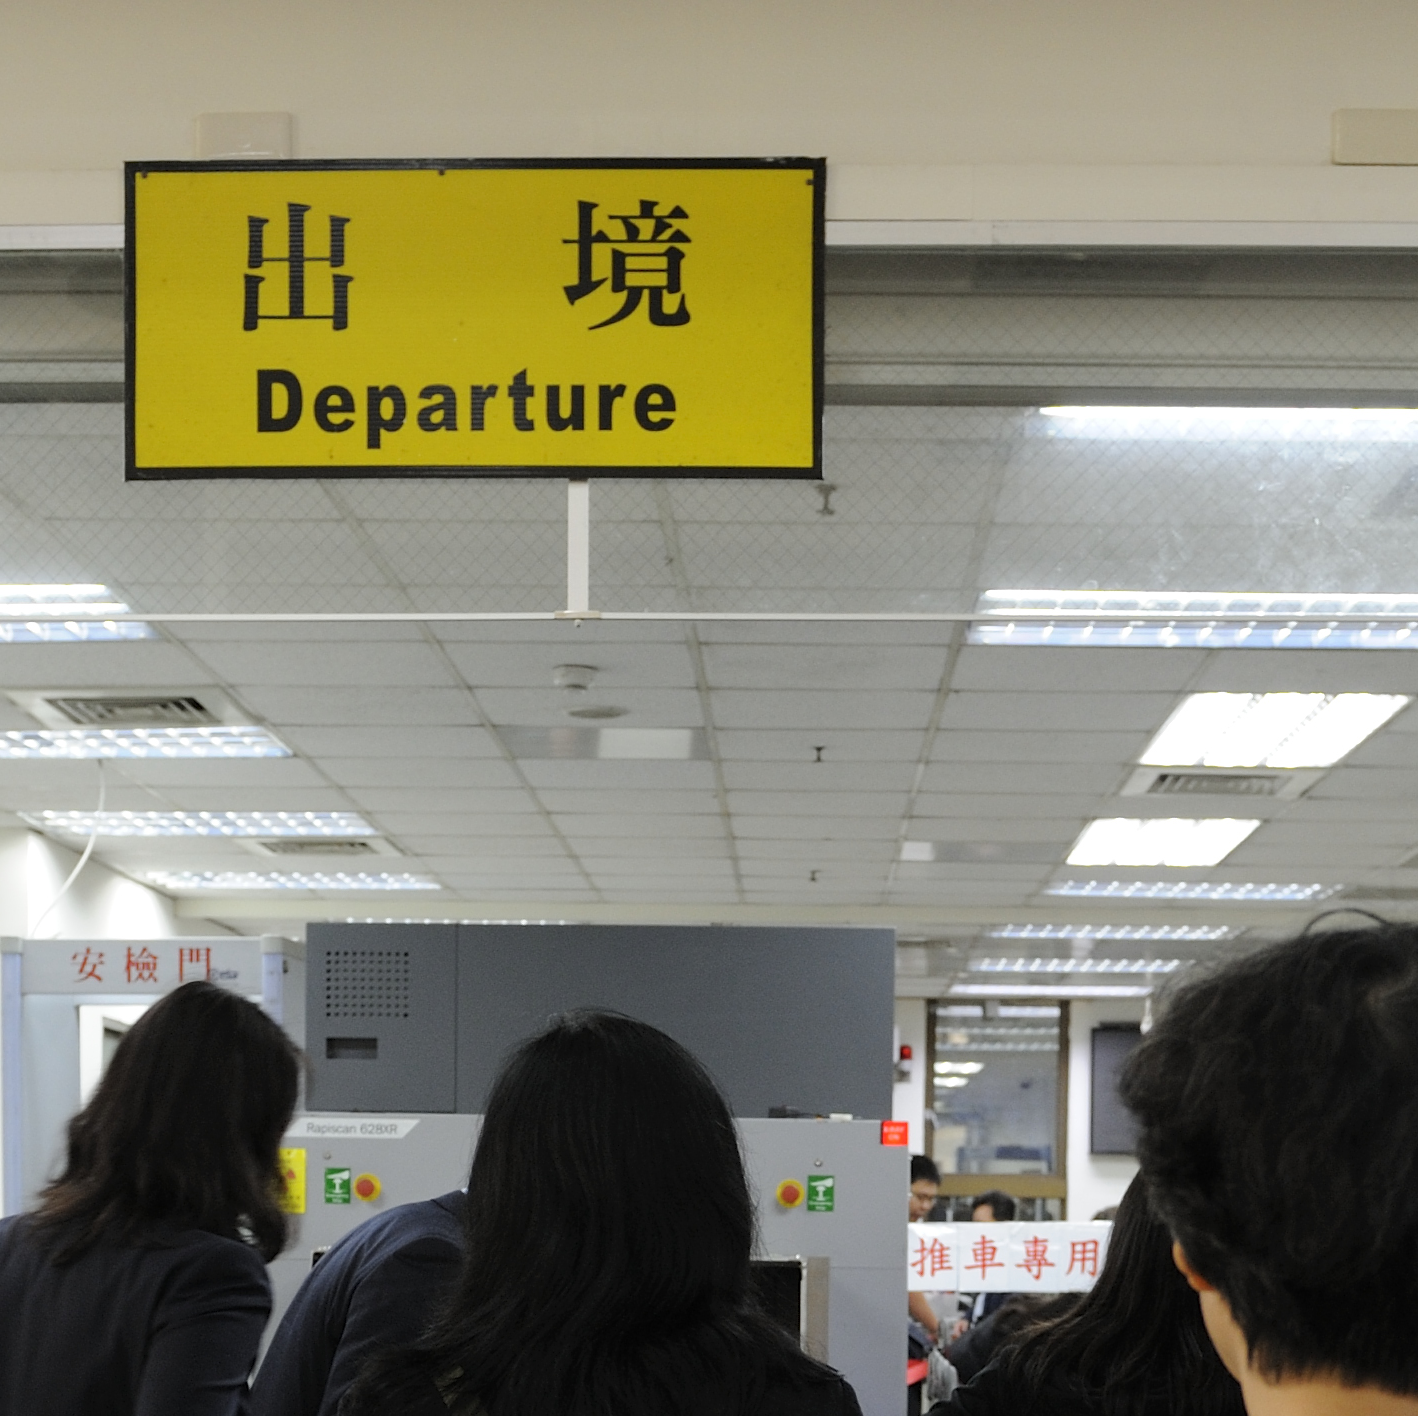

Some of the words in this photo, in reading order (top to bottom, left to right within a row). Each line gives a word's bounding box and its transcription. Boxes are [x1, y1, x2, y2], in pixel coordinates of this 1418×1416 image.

[242, 199, 692, 331] 出境
[256, 367, 677, 449] Departure
[72, 947, 211, 983] 安檢門
[306, 1122, 357, 1134] Rapiscan
[360, 1123, 398, 1135] 628XR
[910, 1235, 1100, 1281] 推車專用
